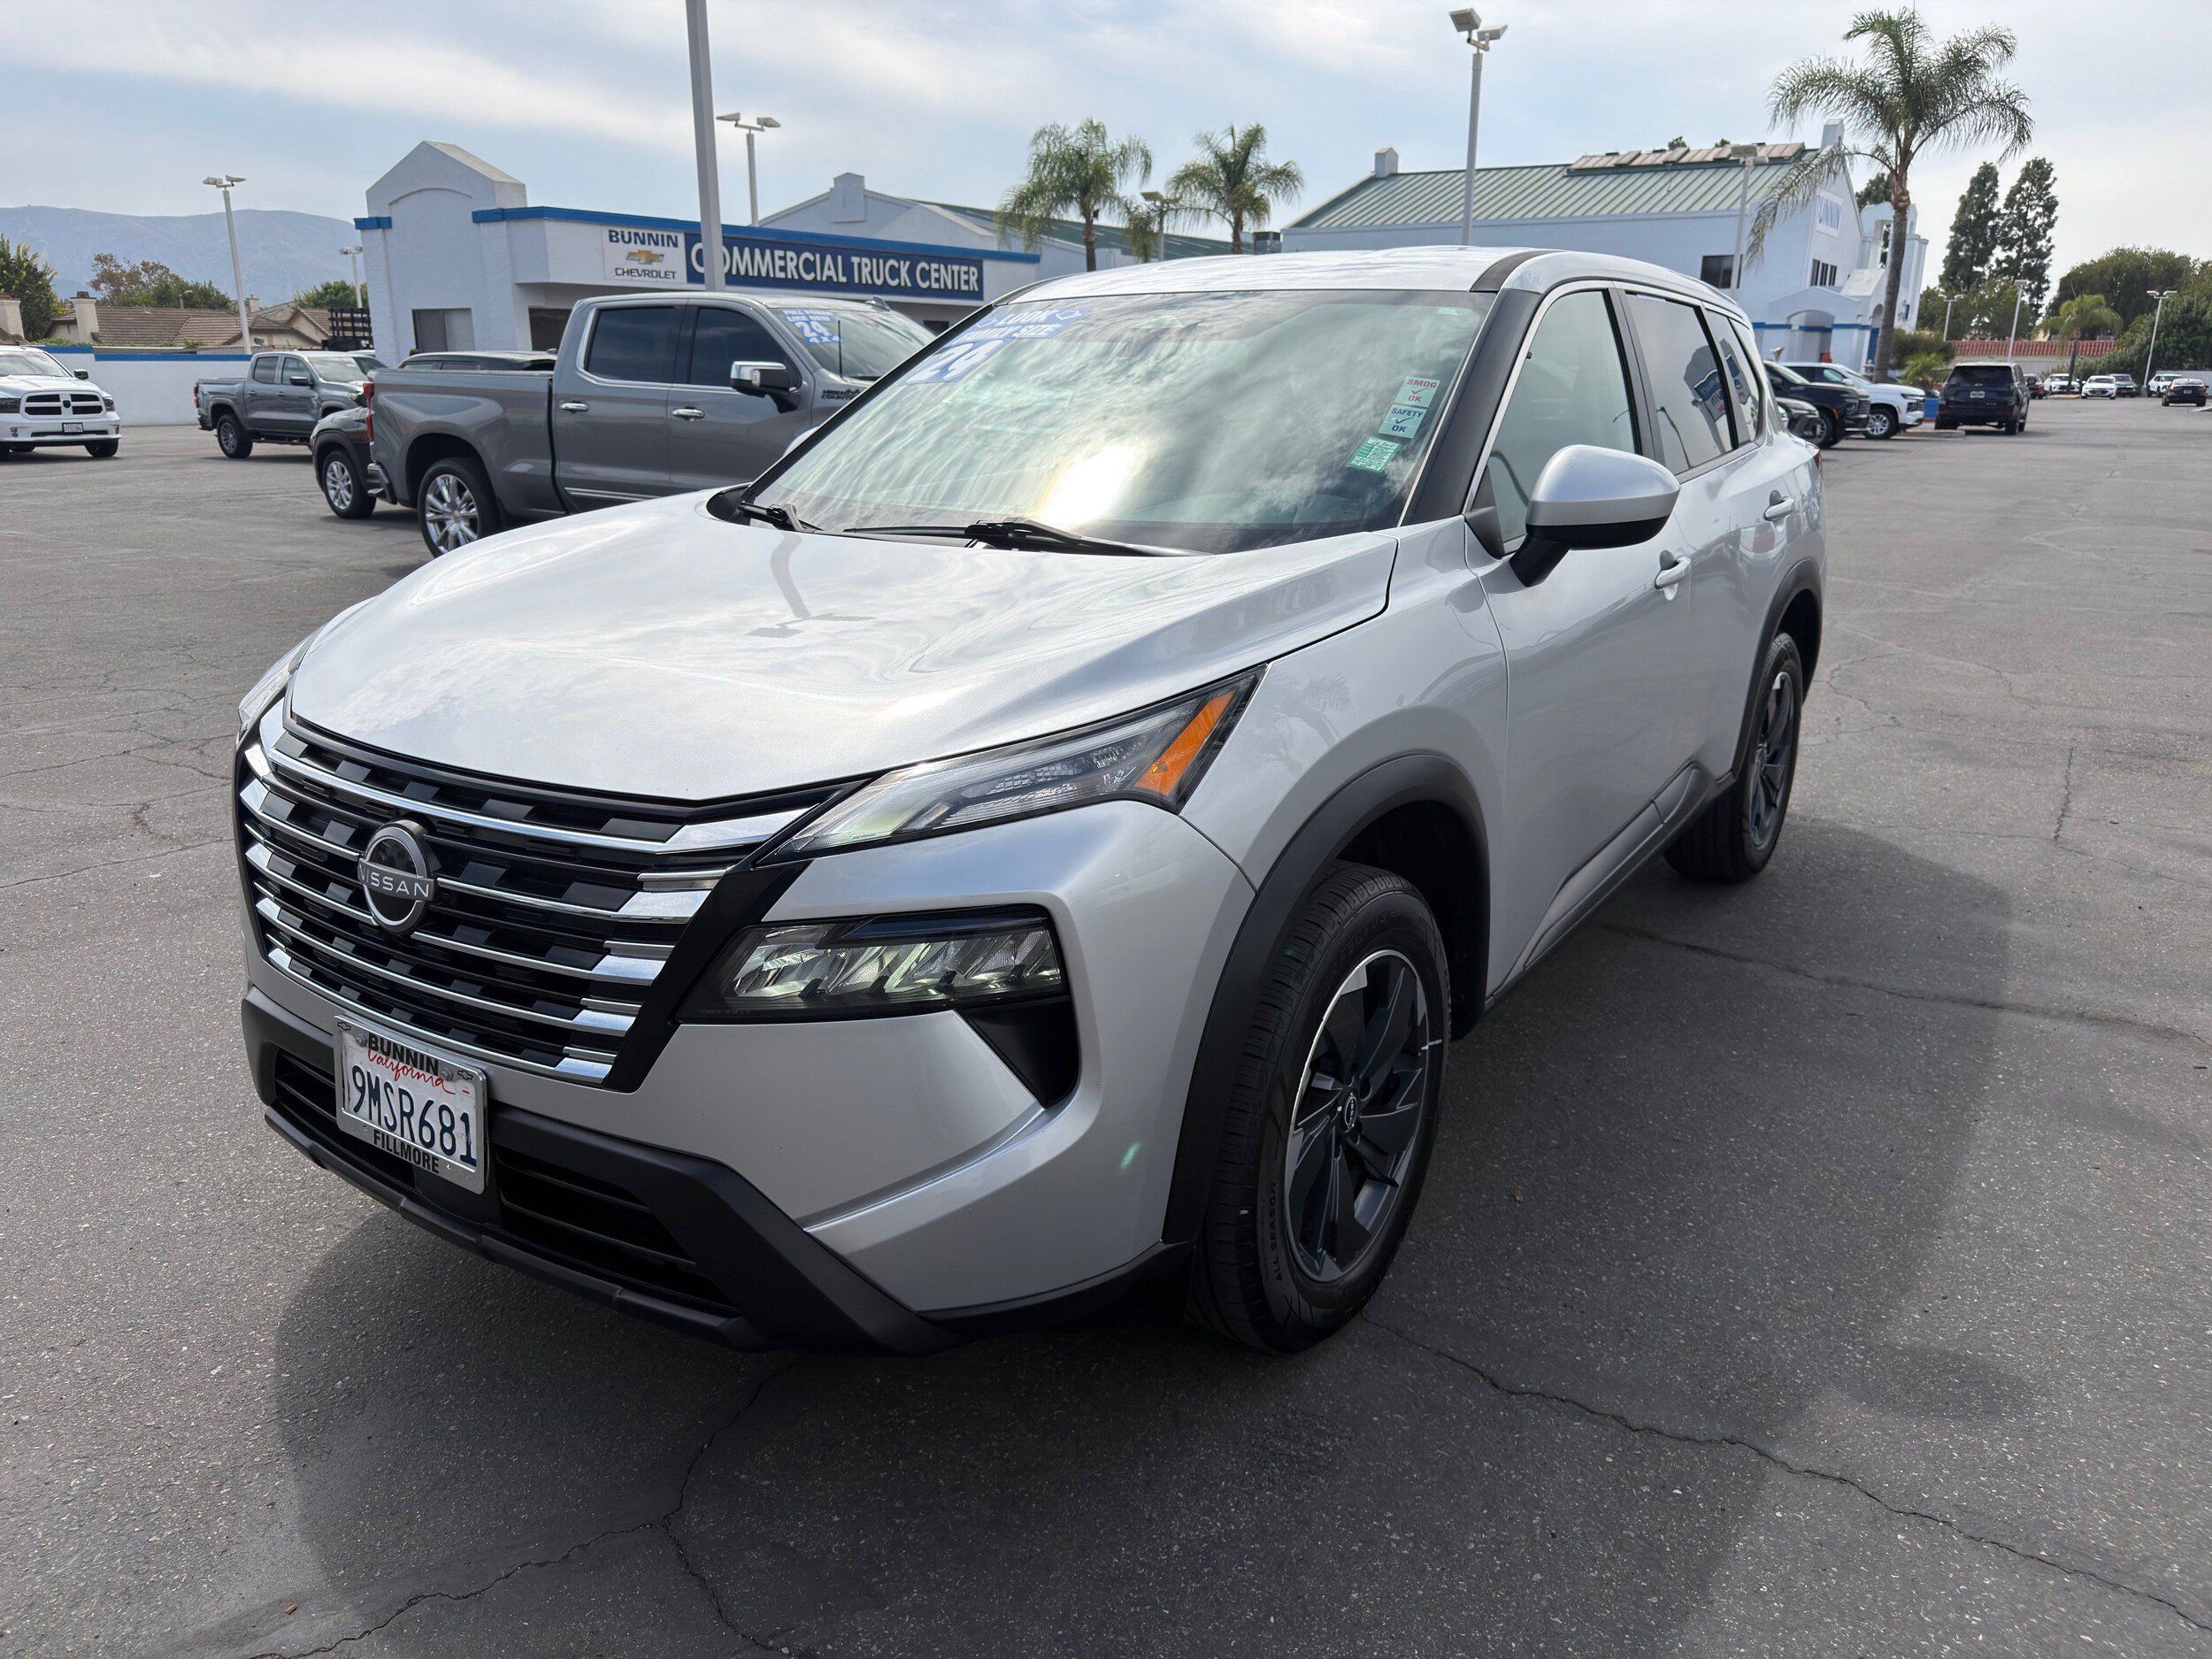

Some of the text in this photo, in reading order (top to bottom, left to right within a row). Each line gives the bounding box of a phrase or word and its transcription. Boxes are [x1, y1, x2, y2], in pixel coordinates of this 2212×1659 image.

[608, 229, 679, 249] BUNNIN
[615, 267, 677, 280] CHEVROLET
[850, 256, 912, 288] TRUCK
[916, 261, 979, 293] CENTER
[905, 340, 1004, 383] 24
[1407, 379, 1437, 388] SMOG
[1391, 407, 1424, 418] SAFETY
[359, 864, 429, 898] NISSAN
[367, 1048, 457, 1095] California
[368, 1033, 439, 1076] BUNNIN
[351, 1065, 478, 1168] 9MSR681
[373, 1129, 440, 1174] FILLMORE
